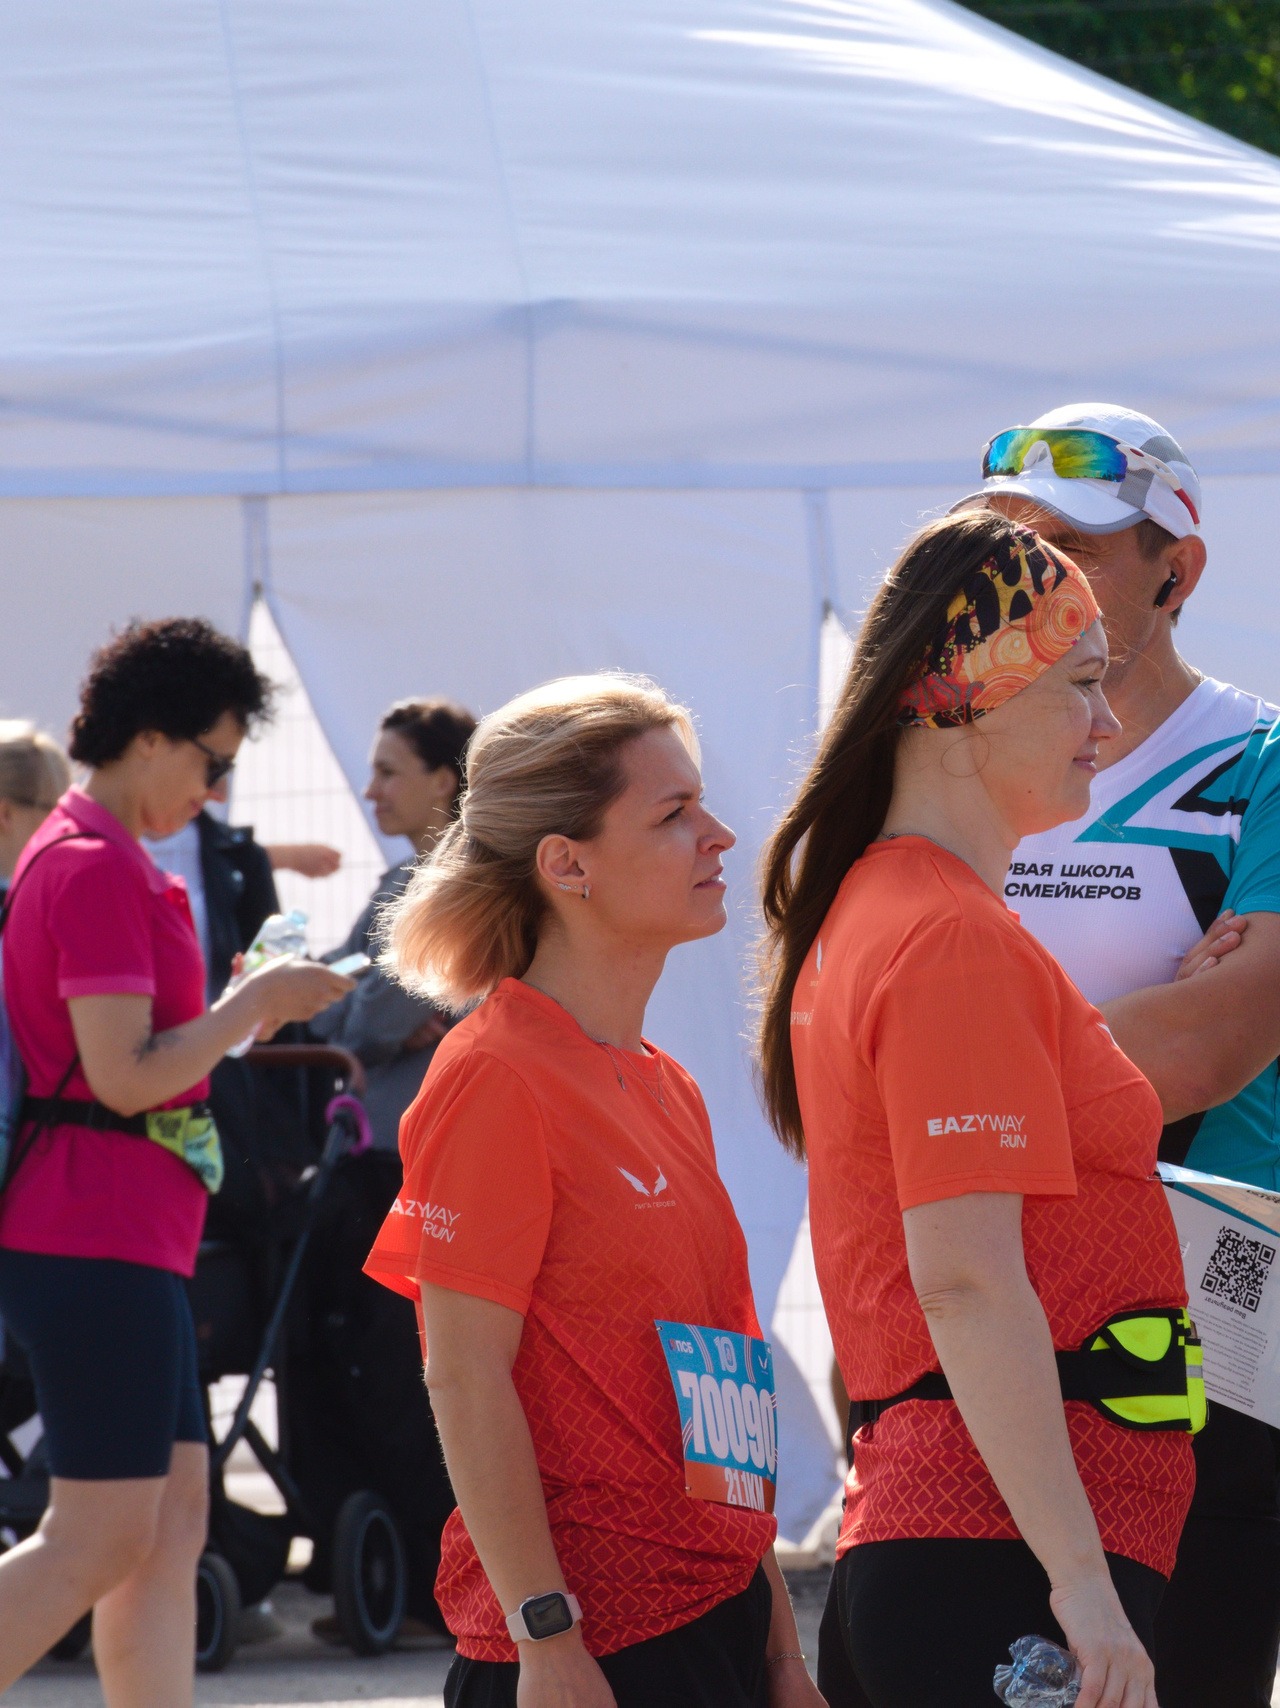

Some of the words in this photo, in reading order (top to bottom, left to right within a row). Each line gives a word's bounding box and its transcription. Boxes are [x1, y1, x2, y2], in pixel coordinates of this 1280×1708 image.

[1061, 865, 1135, 879] ШКОЛА
[1004, 882, 1142, 900] СМЕЙКЕРОВ
[927, 1114, 1026, 1136] EAZYWAY
[1000, 1134, 1027, 1148] RUN
[422, 1220, 456, 1243] RUN
[1204, 1296, 1234, 1313] результат
[1234, 1307, 1247, 1320] Ваш
[714, 1336, 737, 1374] 10
[677, 1370, 777, 1475] 70090
